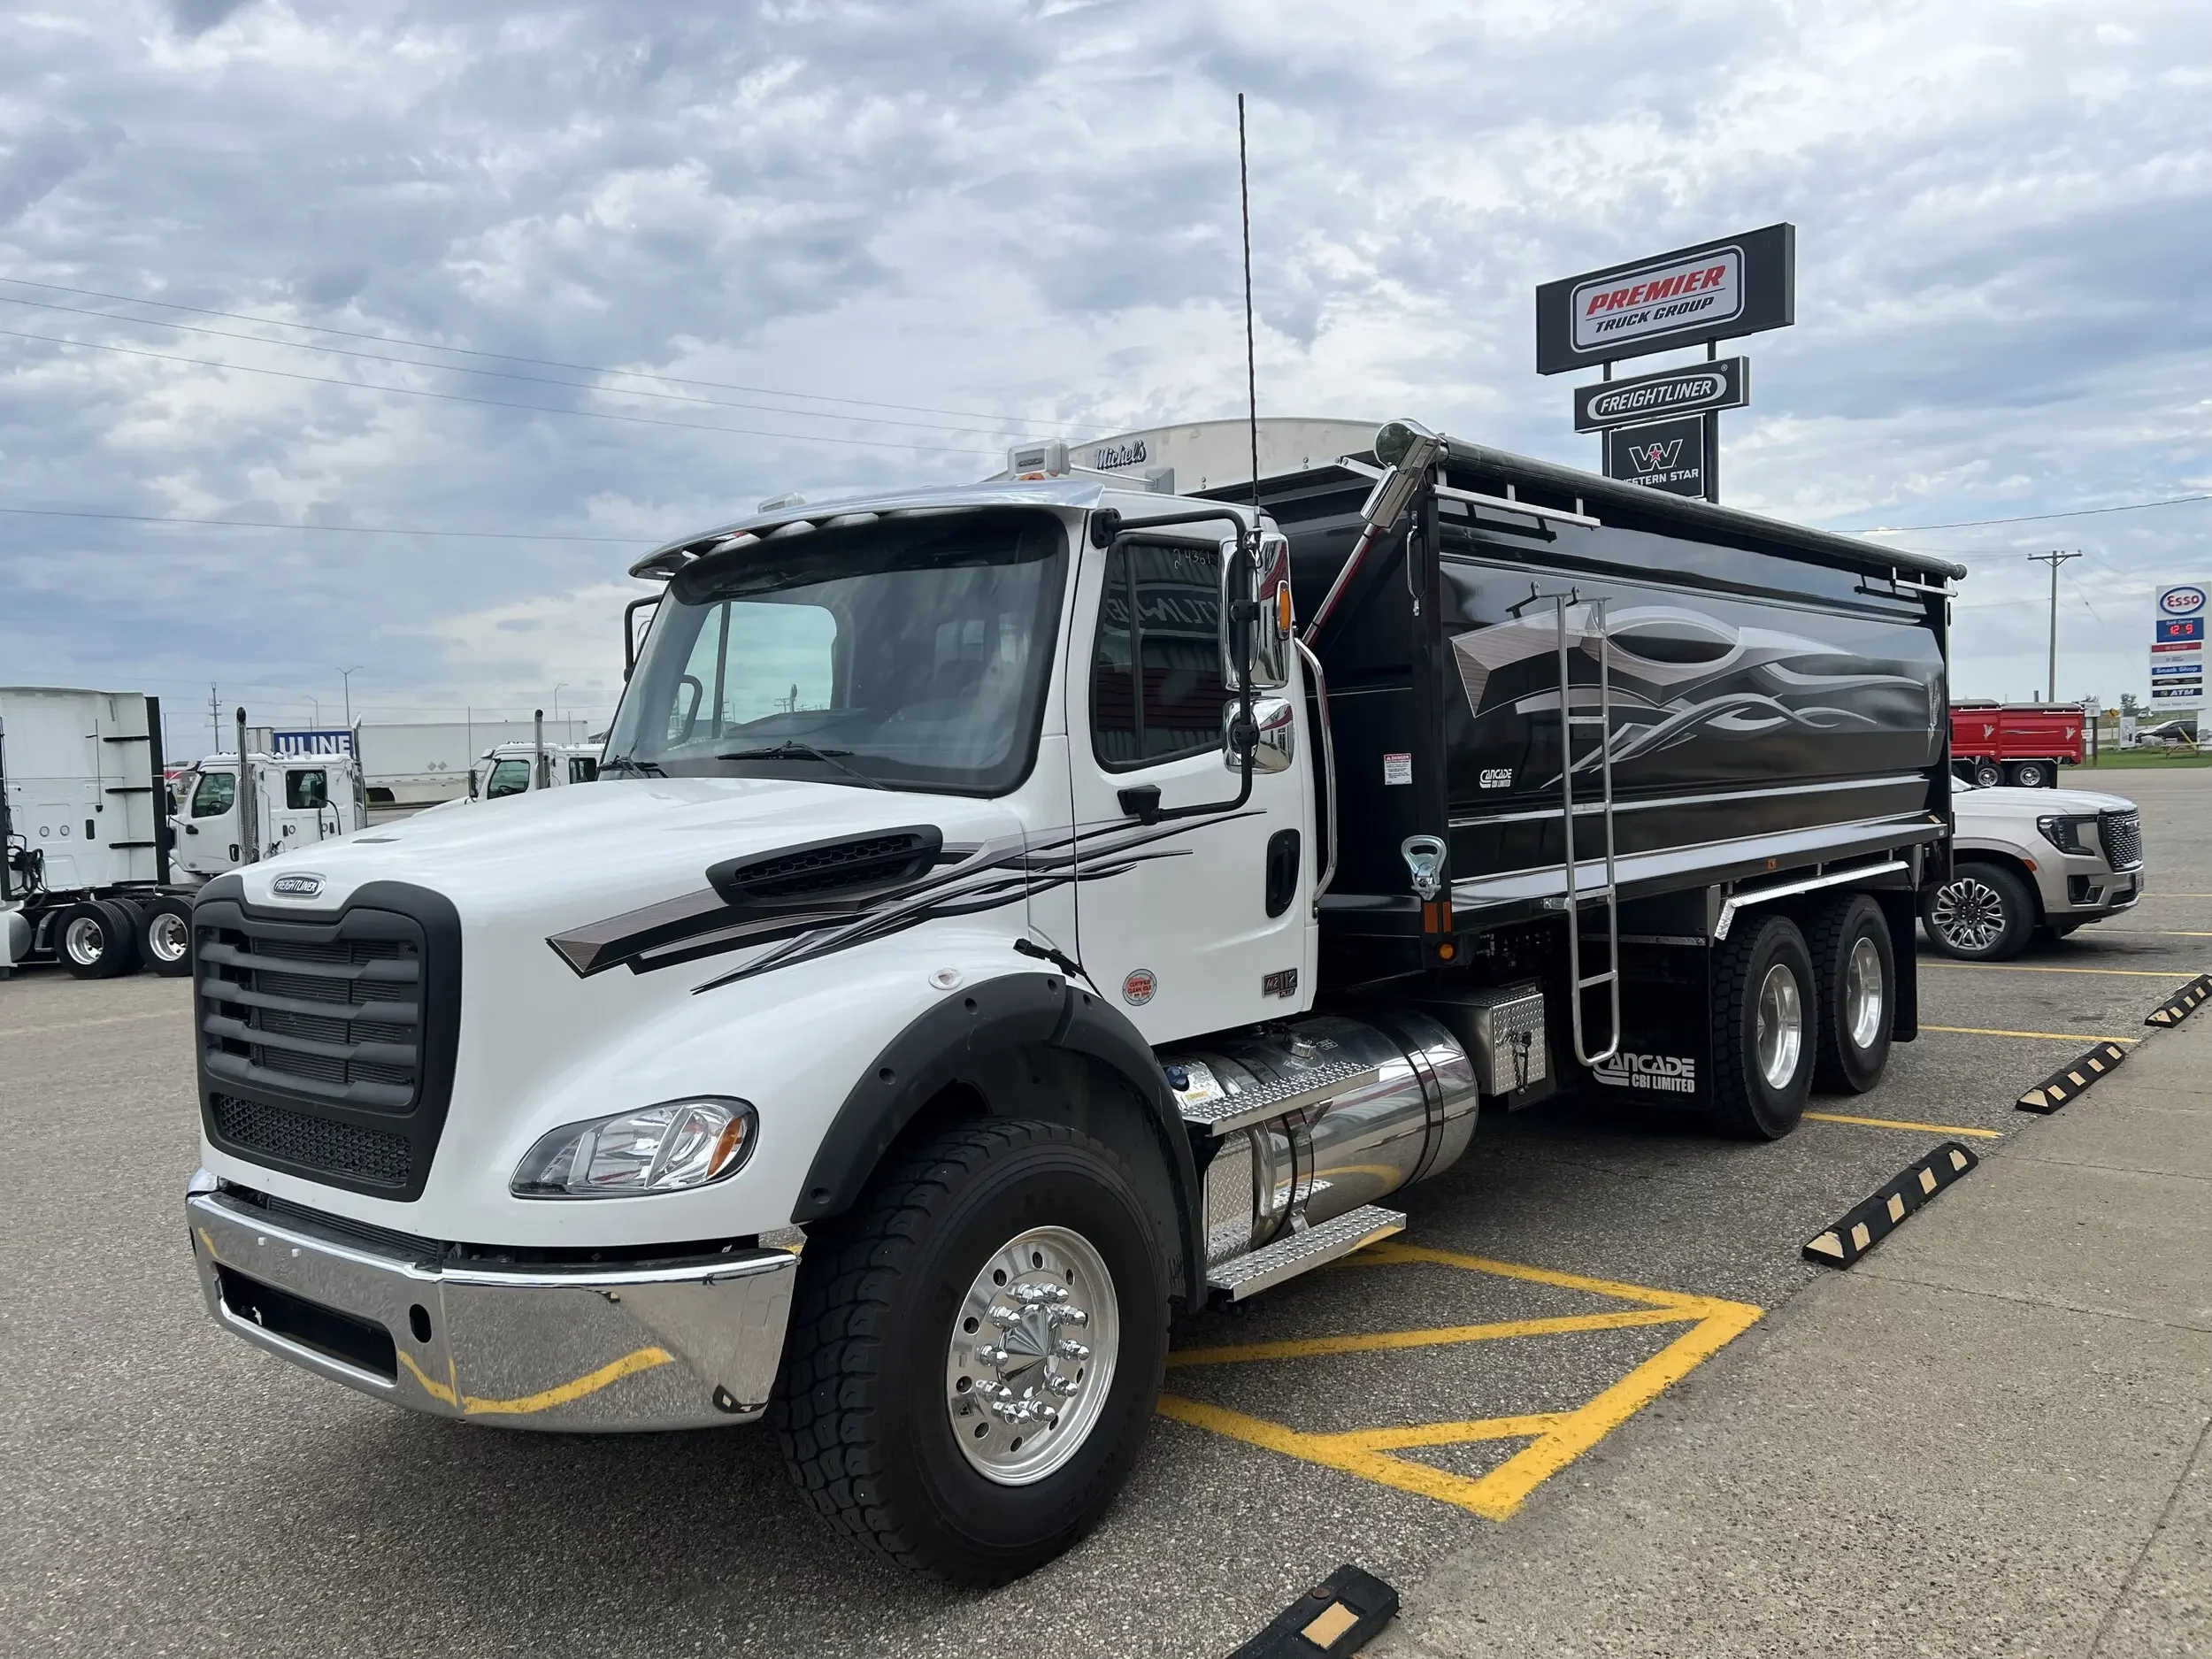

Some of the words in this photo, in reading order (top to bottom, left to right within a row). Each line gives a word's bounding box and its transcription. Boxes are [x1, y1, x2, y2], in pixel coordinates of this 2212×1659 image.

[1586, 265, 1726, 316] PREMIER
[1594, 311, 1650, 334] TRUCK
[1653, 296, 1715, 320] GROUP
[1600, 380, 1712, 413] FREIGHTLINER
[1093, 439, 1148, 470] Michel's
[1671, 468, 1699, 481] STAR
[279, 735, 350, 756] ULINE
[274, 879, 318, 892] FREIGHTLINER
[1279, 970, 1296, 990] 112
[1632, 1073, 1650, 1088] CBI
[1652, 1075, 1695, 1093] LIMITED
